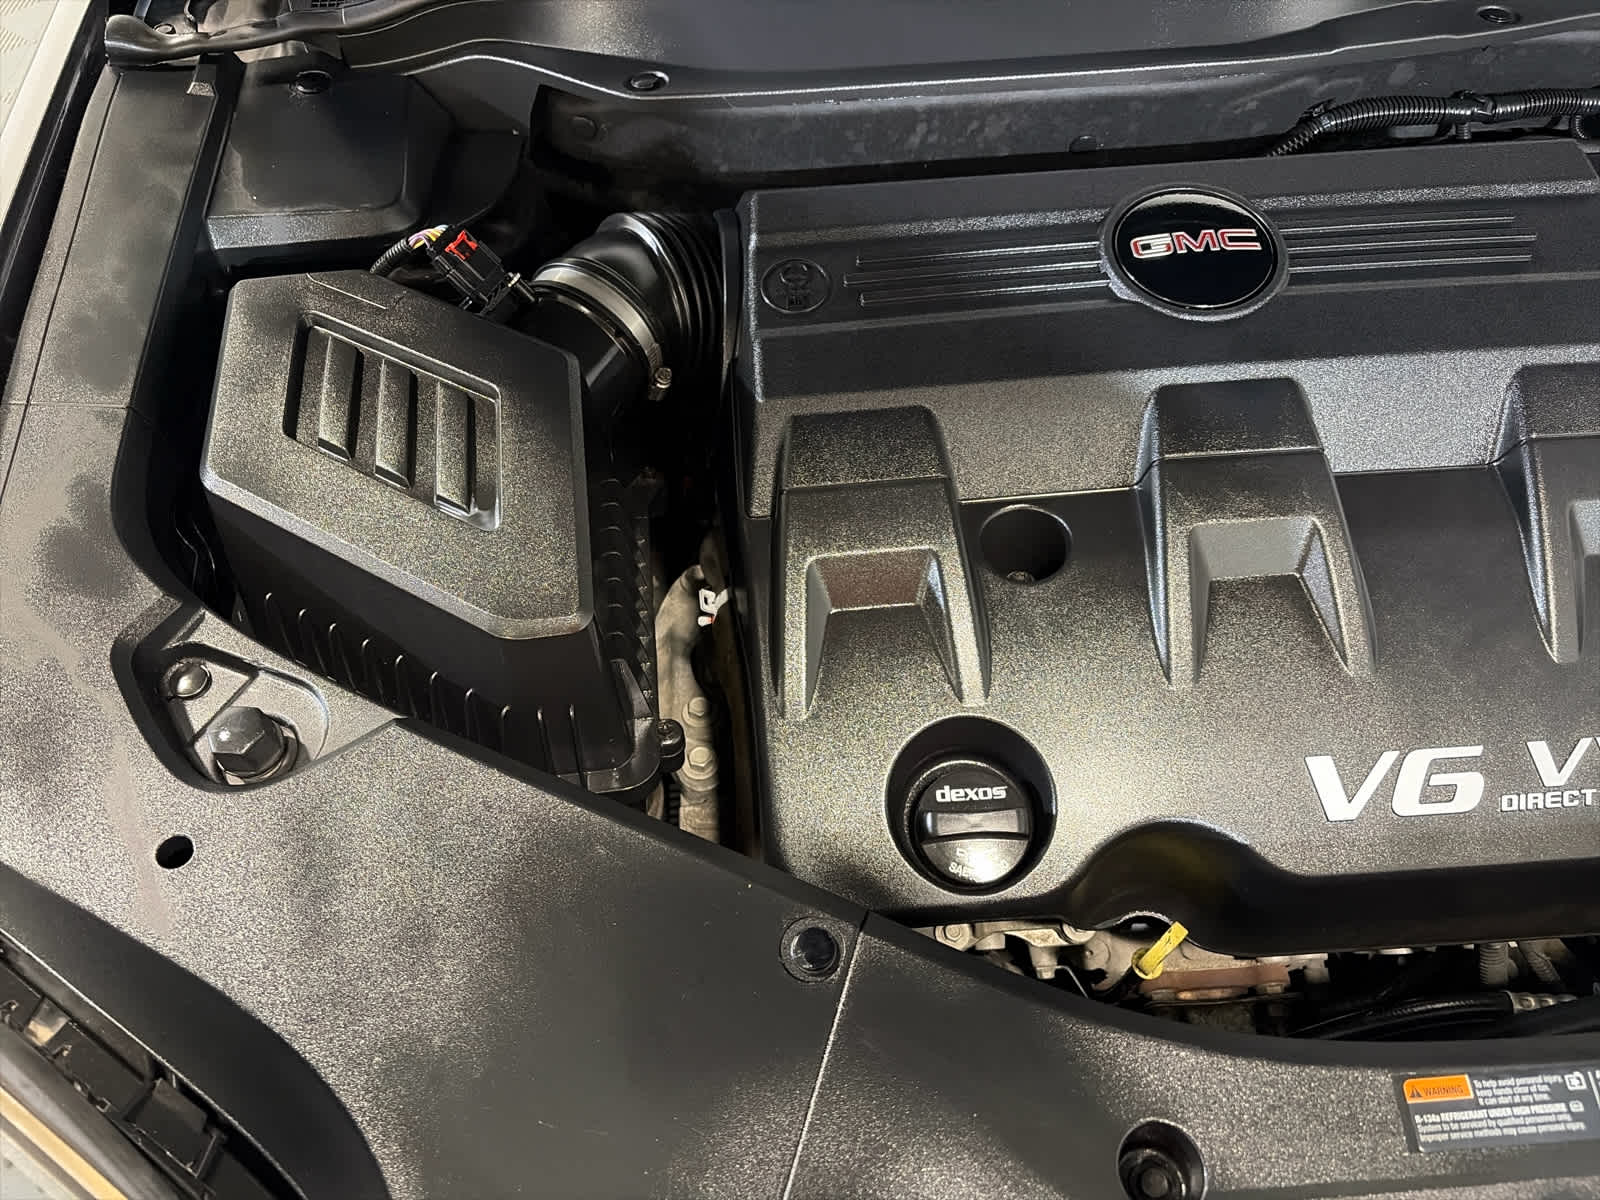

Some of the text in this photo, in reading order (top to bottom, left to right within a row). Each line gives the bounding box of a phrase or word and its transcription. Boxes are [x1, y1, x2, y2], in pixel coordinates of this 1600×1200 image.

[1130, 229, 1262, 259] GMC
[1304, 737, 1600, 822] V6 V
[935, 785, 1008, 803] dexos
[1500, 789, 1598, 812] DIRECT
[1423, 1085, 1464, 1097] WARNING
